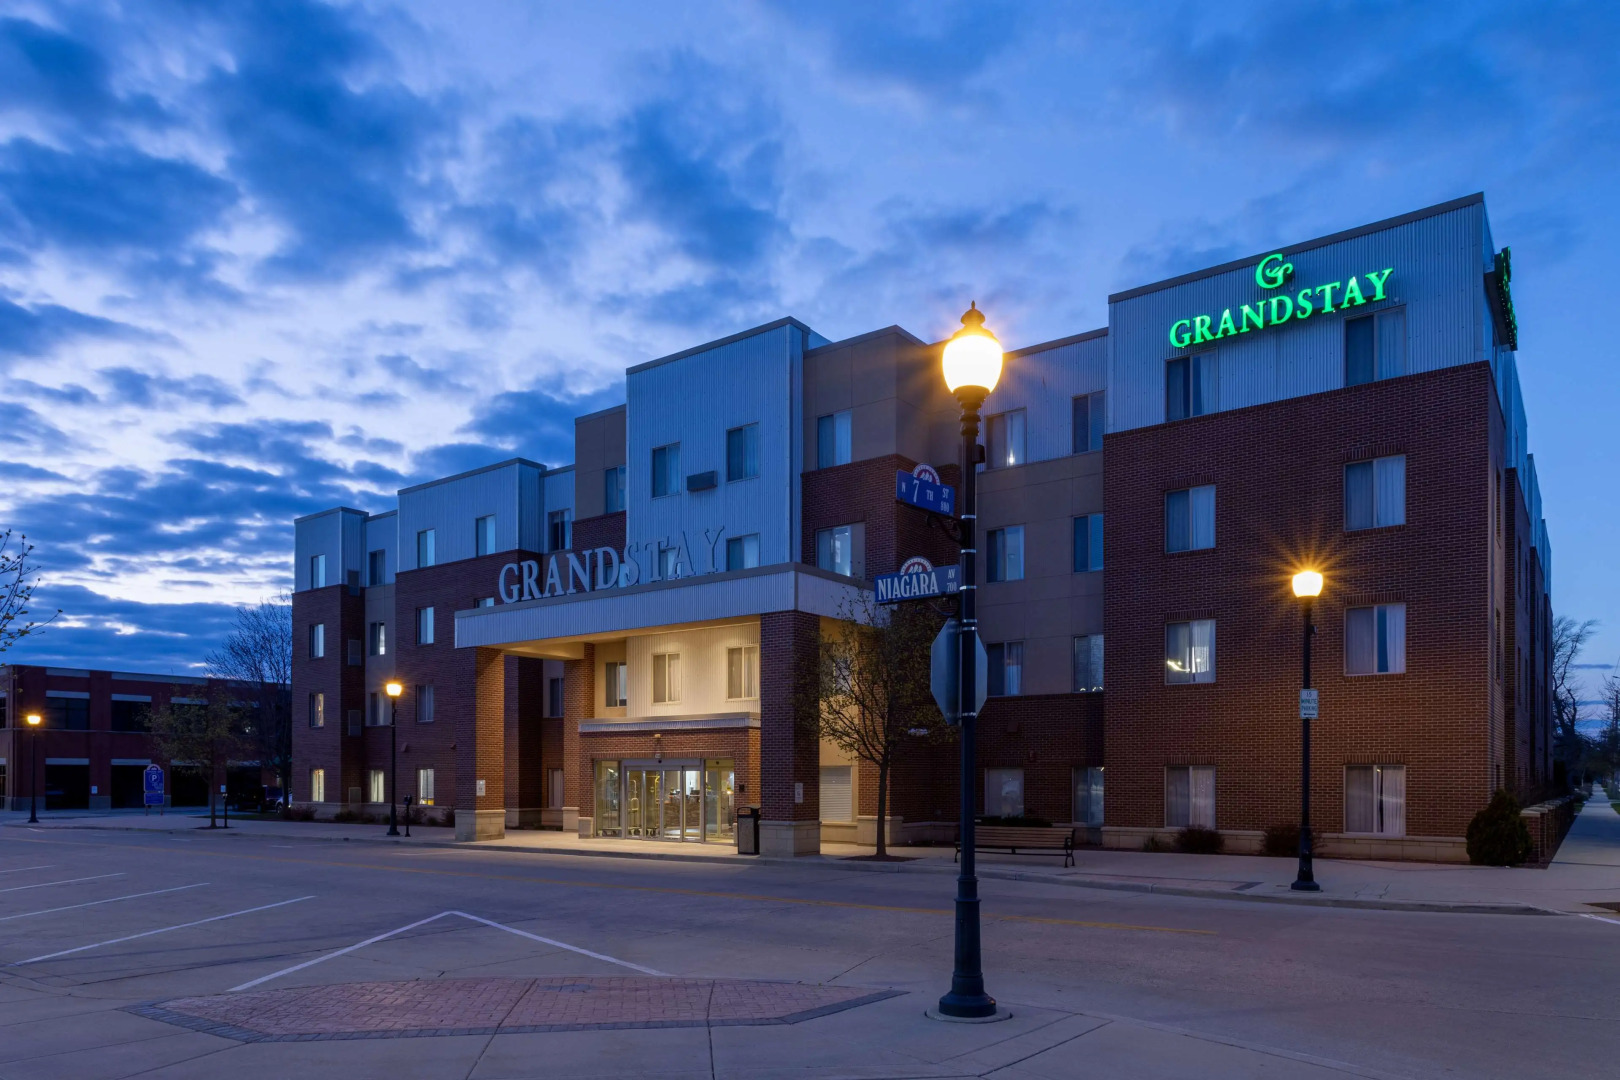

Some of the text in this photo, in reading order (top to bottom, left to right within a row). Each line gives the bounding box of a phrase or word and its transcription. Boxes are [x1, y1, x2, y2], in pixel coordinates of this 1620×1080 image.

[1169, 267, 1394, 348] GRANDSTAY
[901, 479, 950, 503] N 7 TH ST
[498, 525, 725, 604] GRANDSTAY
[878, 568, 956, 600] NIAGARA AV
